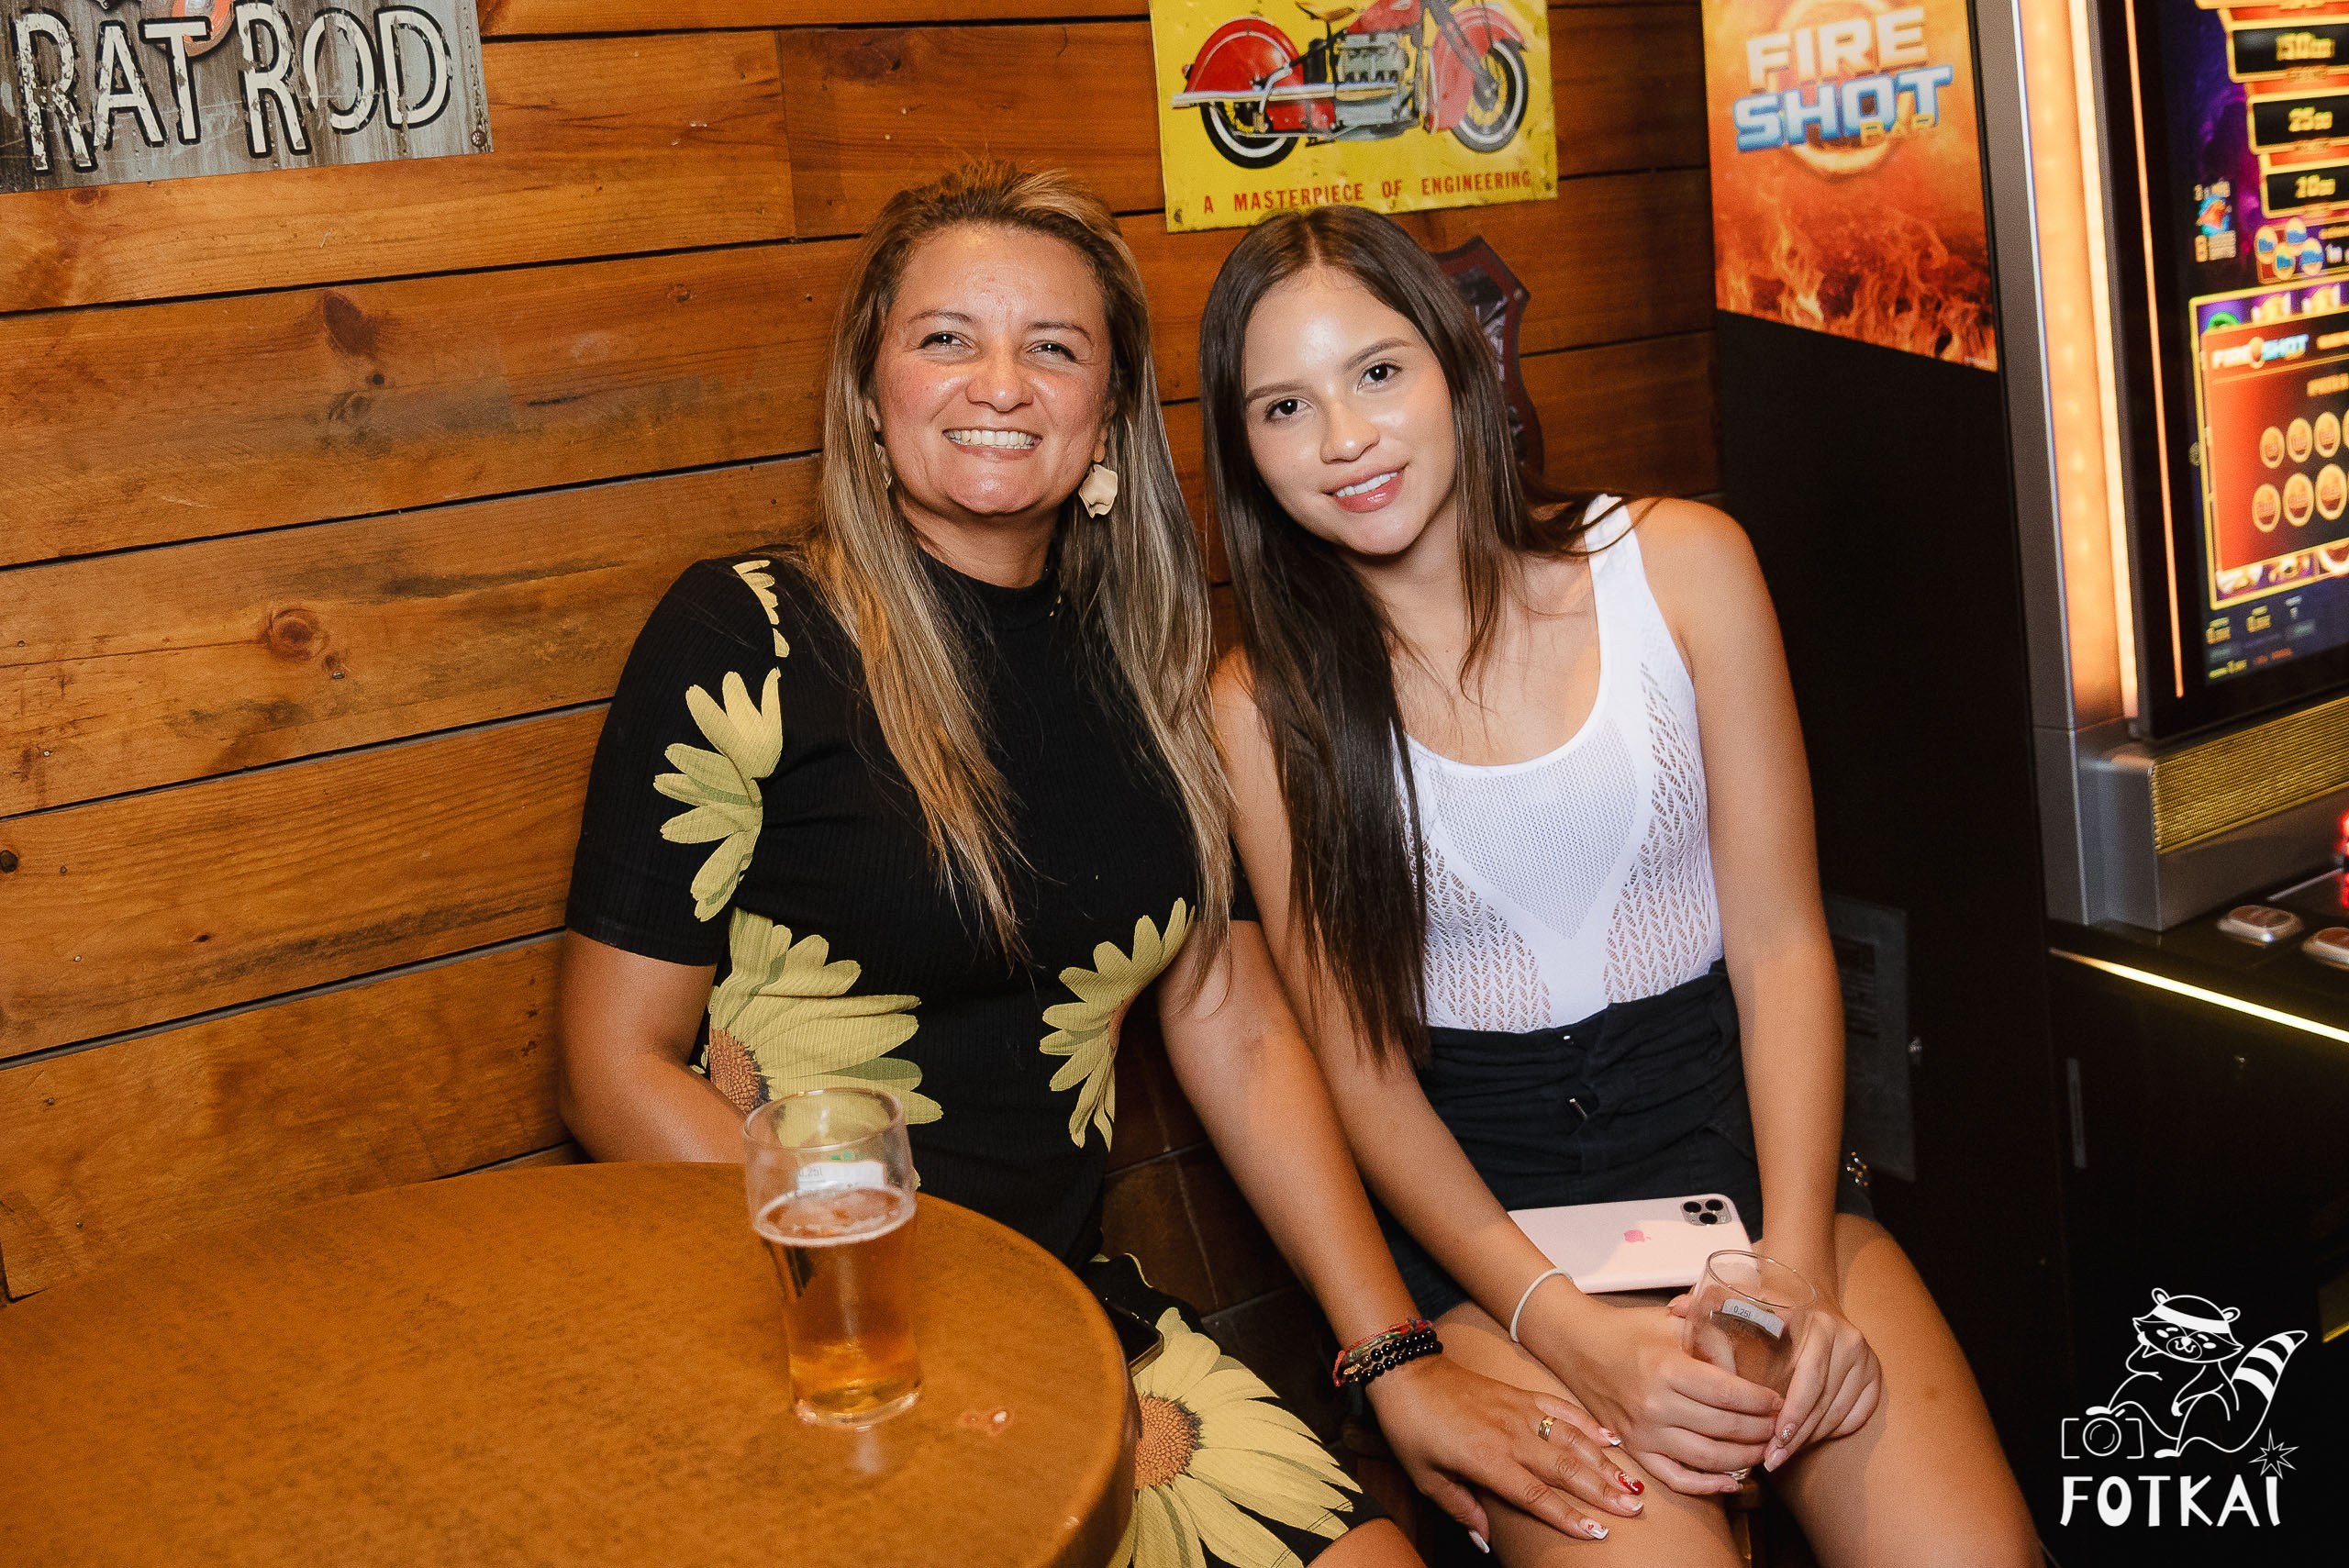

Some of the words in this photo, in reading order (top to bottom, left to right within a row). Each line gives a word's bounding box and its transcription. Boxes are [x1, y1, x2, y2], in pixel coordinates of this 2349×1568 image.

[13, 7, 210, 175] RAT
[232, 0, 453, 158] ROD
[1746, 8, 1927, 88] FIRE
[1733, 64, 1954, 152] SHOT
[1860, 113, 1936, 147] BAR
[1203, 194, 1214, 215] A
[1234, 183, 1365, 211] MASTERPIECE
[1382, 179, 1403, 198] OF
[1421, 170, 1532, 196] ENGINEERING
